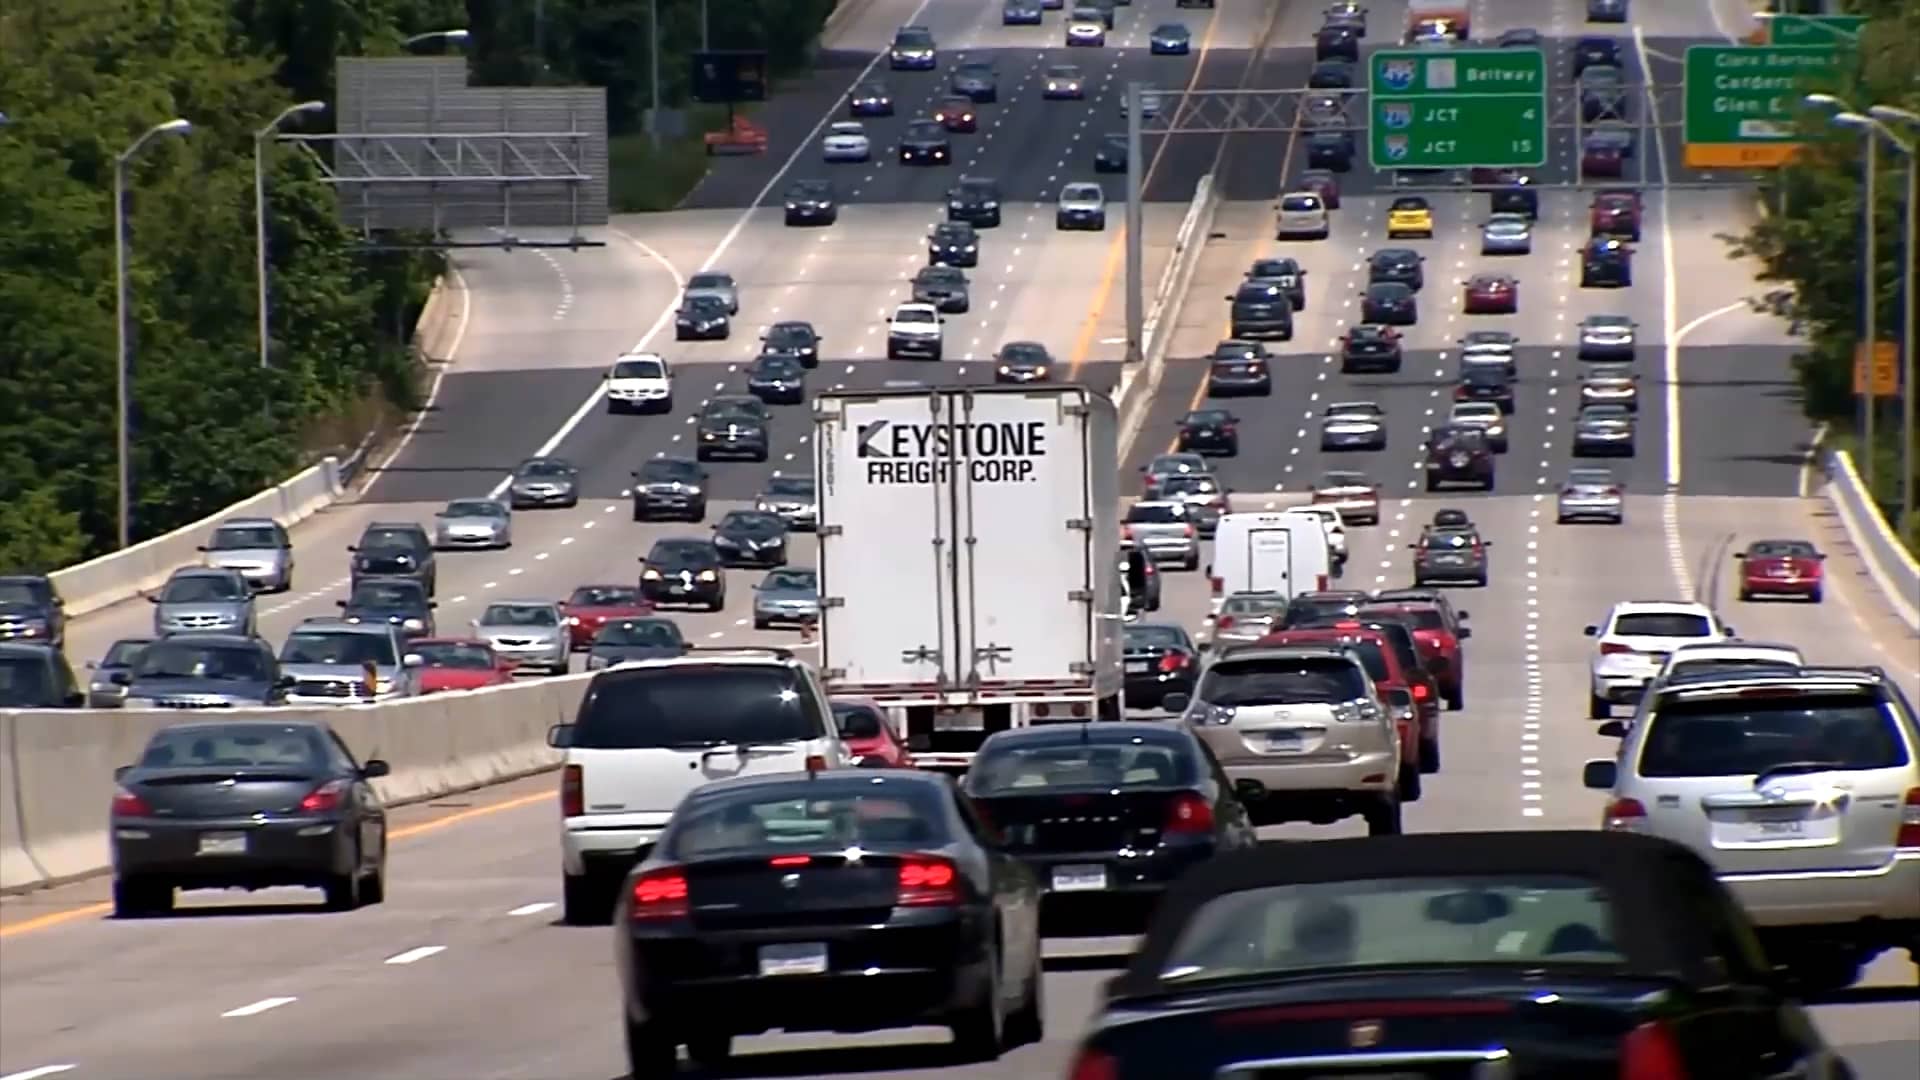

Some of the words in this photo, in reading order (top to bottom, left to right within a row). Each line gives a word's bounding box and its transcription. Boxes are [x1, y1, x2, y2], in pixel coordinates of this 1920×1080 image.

[1467, 68, 1536, 83] Beltway
[1713, 97, 1760, 113] Glen
[1424, 108, 1460, 122] JCT
[1522, 108, 1535, 120] 4
[1423, 141, 1457, 153] JCT
[1512, 140, 1532, 153] 15
[858, 420, 1045, 458] KEYSTONE
[868, 461, 962, 484] FREIGHT
[971, 460, 1037, 482] CORP.
